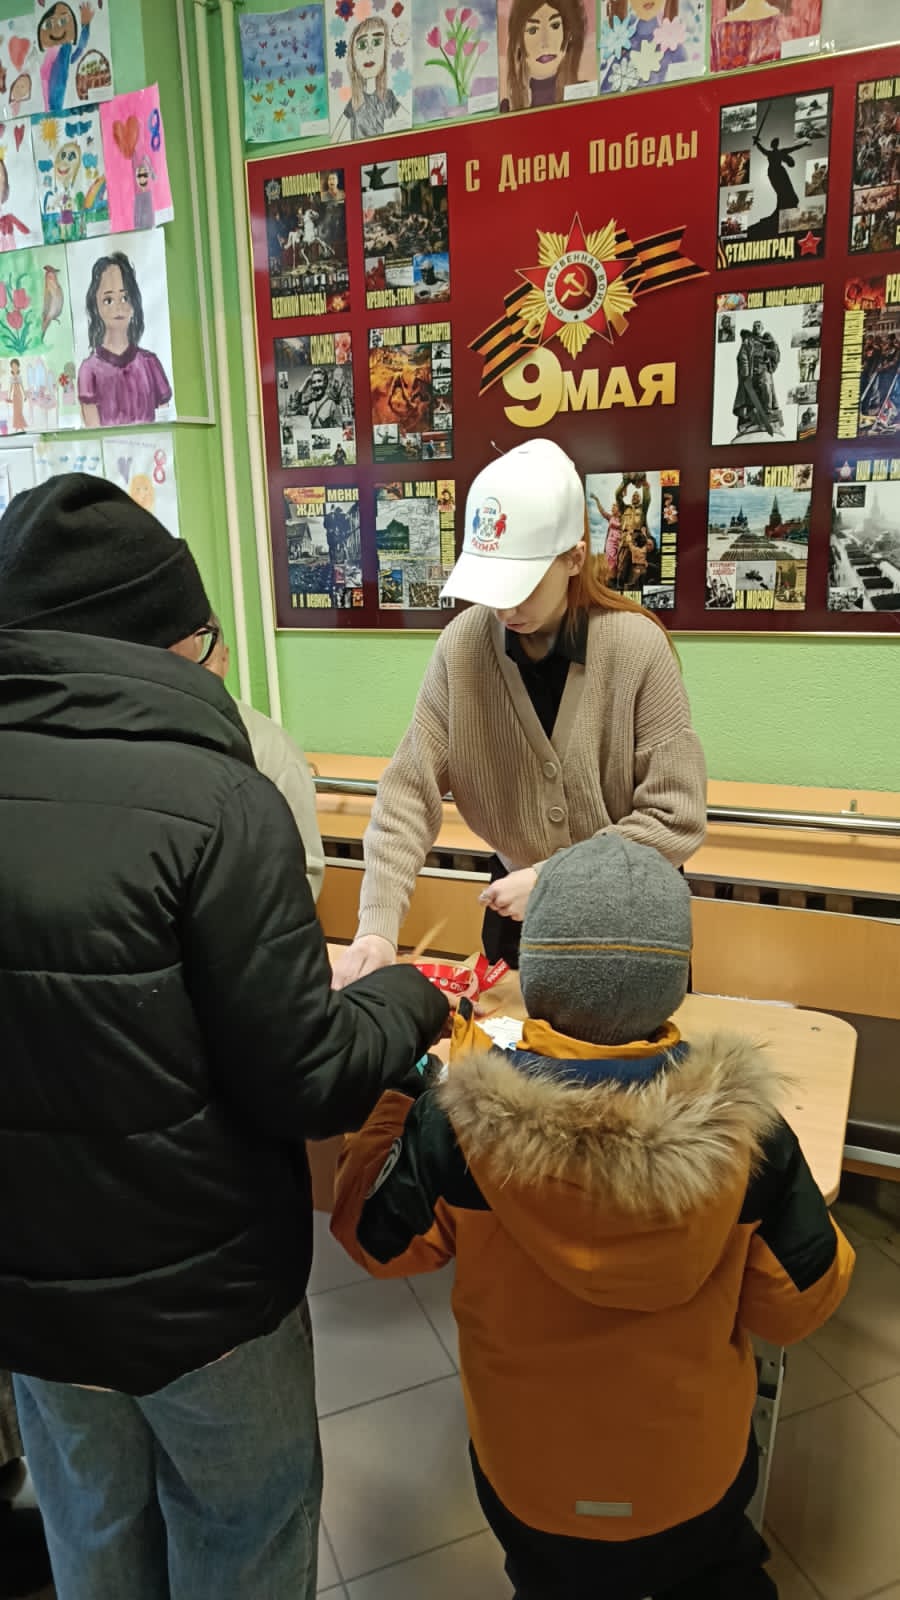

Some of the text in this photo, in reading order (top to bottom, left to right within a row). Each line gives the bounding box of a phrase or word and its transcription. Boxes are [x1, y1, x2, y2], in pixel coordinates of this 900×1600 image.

[149, 108, 161, 152] 8
[465, 130, 698, 192] С Днем Победы
[725, 236, 795, 263] СТАЛИНГРАД
[502, 345, 676, 428] 9 МАЯ
[153, 449, 167, 484] 8
[764, 465, 794, 487] БИТВА
[735, 590, 774, 610] ЗА МОСКВУ
